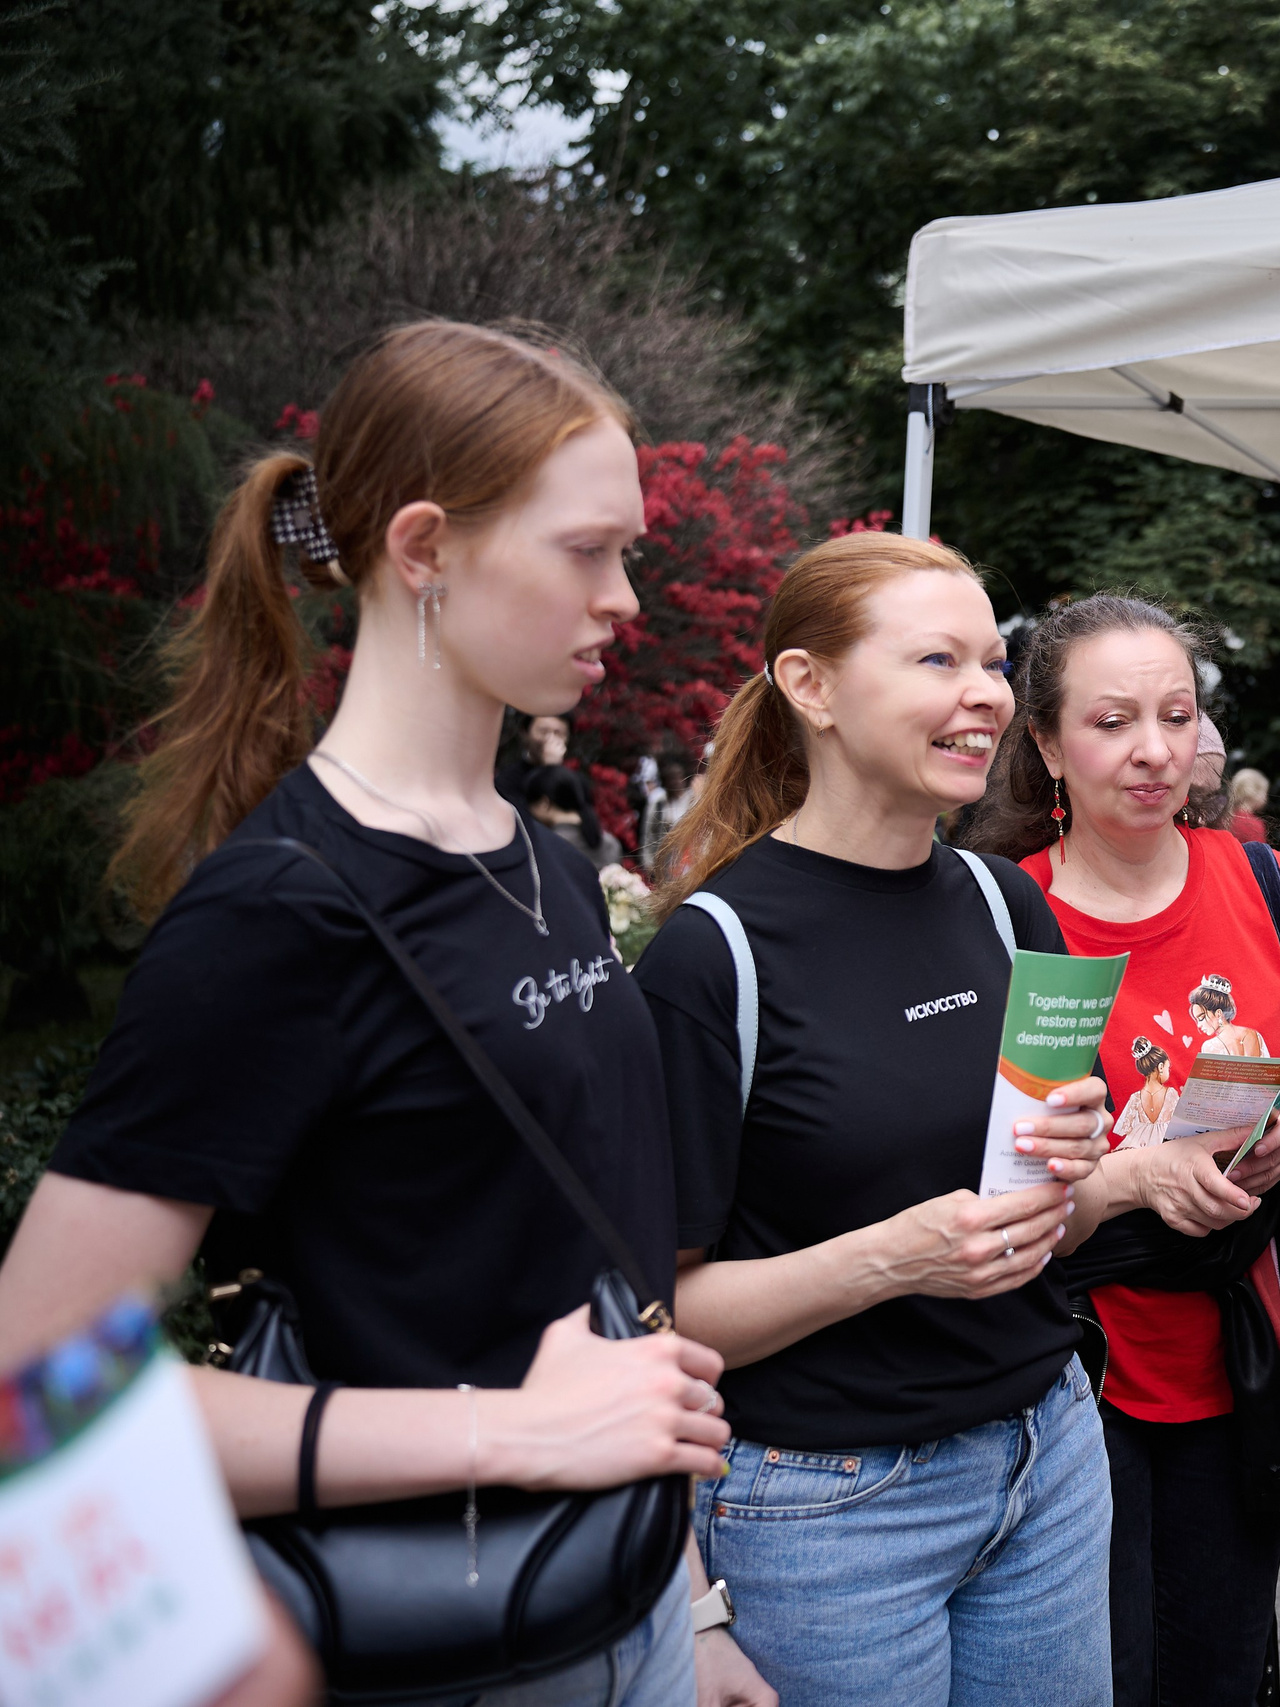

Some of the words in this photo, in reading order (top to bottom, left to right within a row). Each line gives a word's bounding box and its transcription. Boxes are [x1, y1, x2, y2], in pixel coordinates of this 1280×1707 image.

[570, 955, 614, 1012] light
[904, 990, 978, 1023] ИСКУССТВО
[1028, 992, 1081, 1011] Together
[1083, 998, 1097, 1009] we
[1099, 996, 1113, 1009] can
[1036, 1015, 1077, 1028] restore
[1079, 1016, 1104, 1028] more
[1016, 1031, 1075, 1050] destroyed
